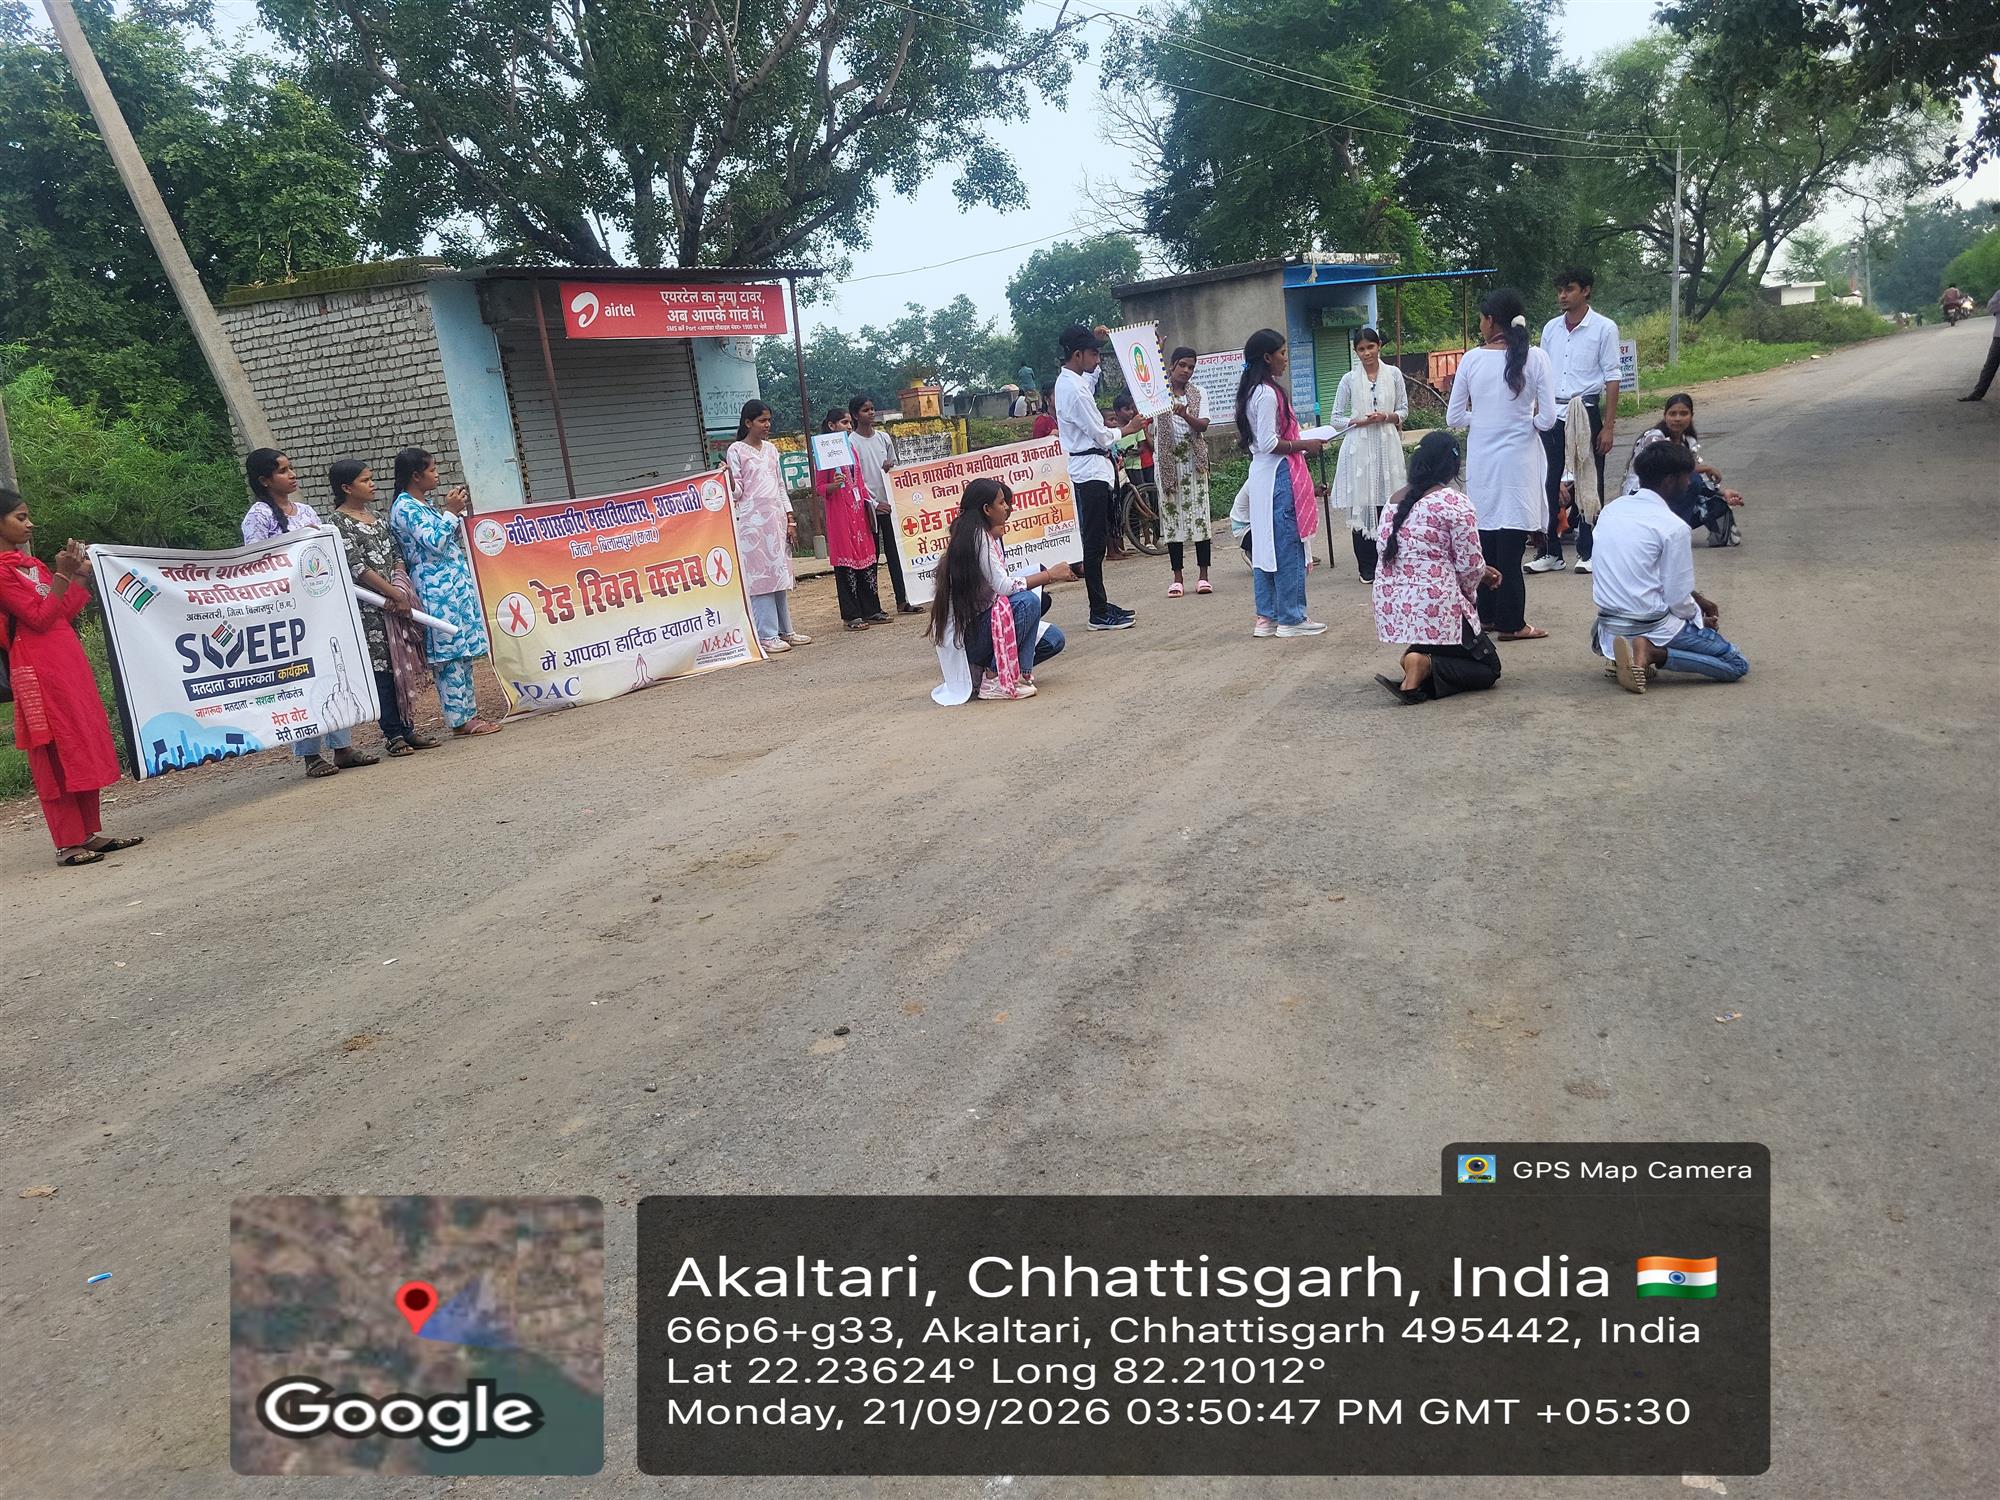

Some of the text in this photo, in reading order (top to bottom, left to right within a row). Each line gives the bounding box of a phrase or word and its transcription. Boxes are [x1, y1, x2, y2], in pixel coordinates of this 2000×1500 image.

[604, 303, 636, 317] airtel
[659, 287, 765, 305] एयरटेल का नया टावर,
[667, 308, 688, 323] अब
[691, 304, 727, 322] आपके
[894, 440, 1063, 490] नवीन शासकीय महाविद्यालय अकलतरी
[931, 480, 959, 500] जिला
[504, 484, 702, 546] नवीन शासकीय महाविद्यालय, अकलतरी
[919, 504, 943, 533] रेड
[570, 541, 593, 559] जिला
[597, 535, 633, 551] बिलासपुर
[911, 553, 940, 566] IQAC
[1047, 520, 1076, 533] NAAC
[917, 536, 928, 554] में
[1012, 513, 1050, 533] स्वागत
[159, 563, 214, 582] नवीन
[216, 552, 293, 580] शासकीय
[184, 577, 291, 605] महाविद्यालय
[529, 555, 707, 625] रेड रिबन क्लब
[186, 607, 226, 622] अकलतरी,
[175, 617, 306, 674] SWEEP
[540, 650, 556, 672] में
[563, 641, 611, 668] आपका
[614, 626, 657, 652] हार्दिक
[660, 615, 704, 641] स्वागत
[700, 628, 743, 654] NAAC
[190, 680, 225, 696] मतदाता
[277, 663, 309, 680] कार्यक्रम
[223, 699, 248, 713] मतदाता
[255, 694, 276, 707] सशक्त
[277, 686, 304, 702] लोकतंत्र
[271, 707, 309, 727] मेरा वोट
[275, 723, 319, 743] मेरी ताकत
